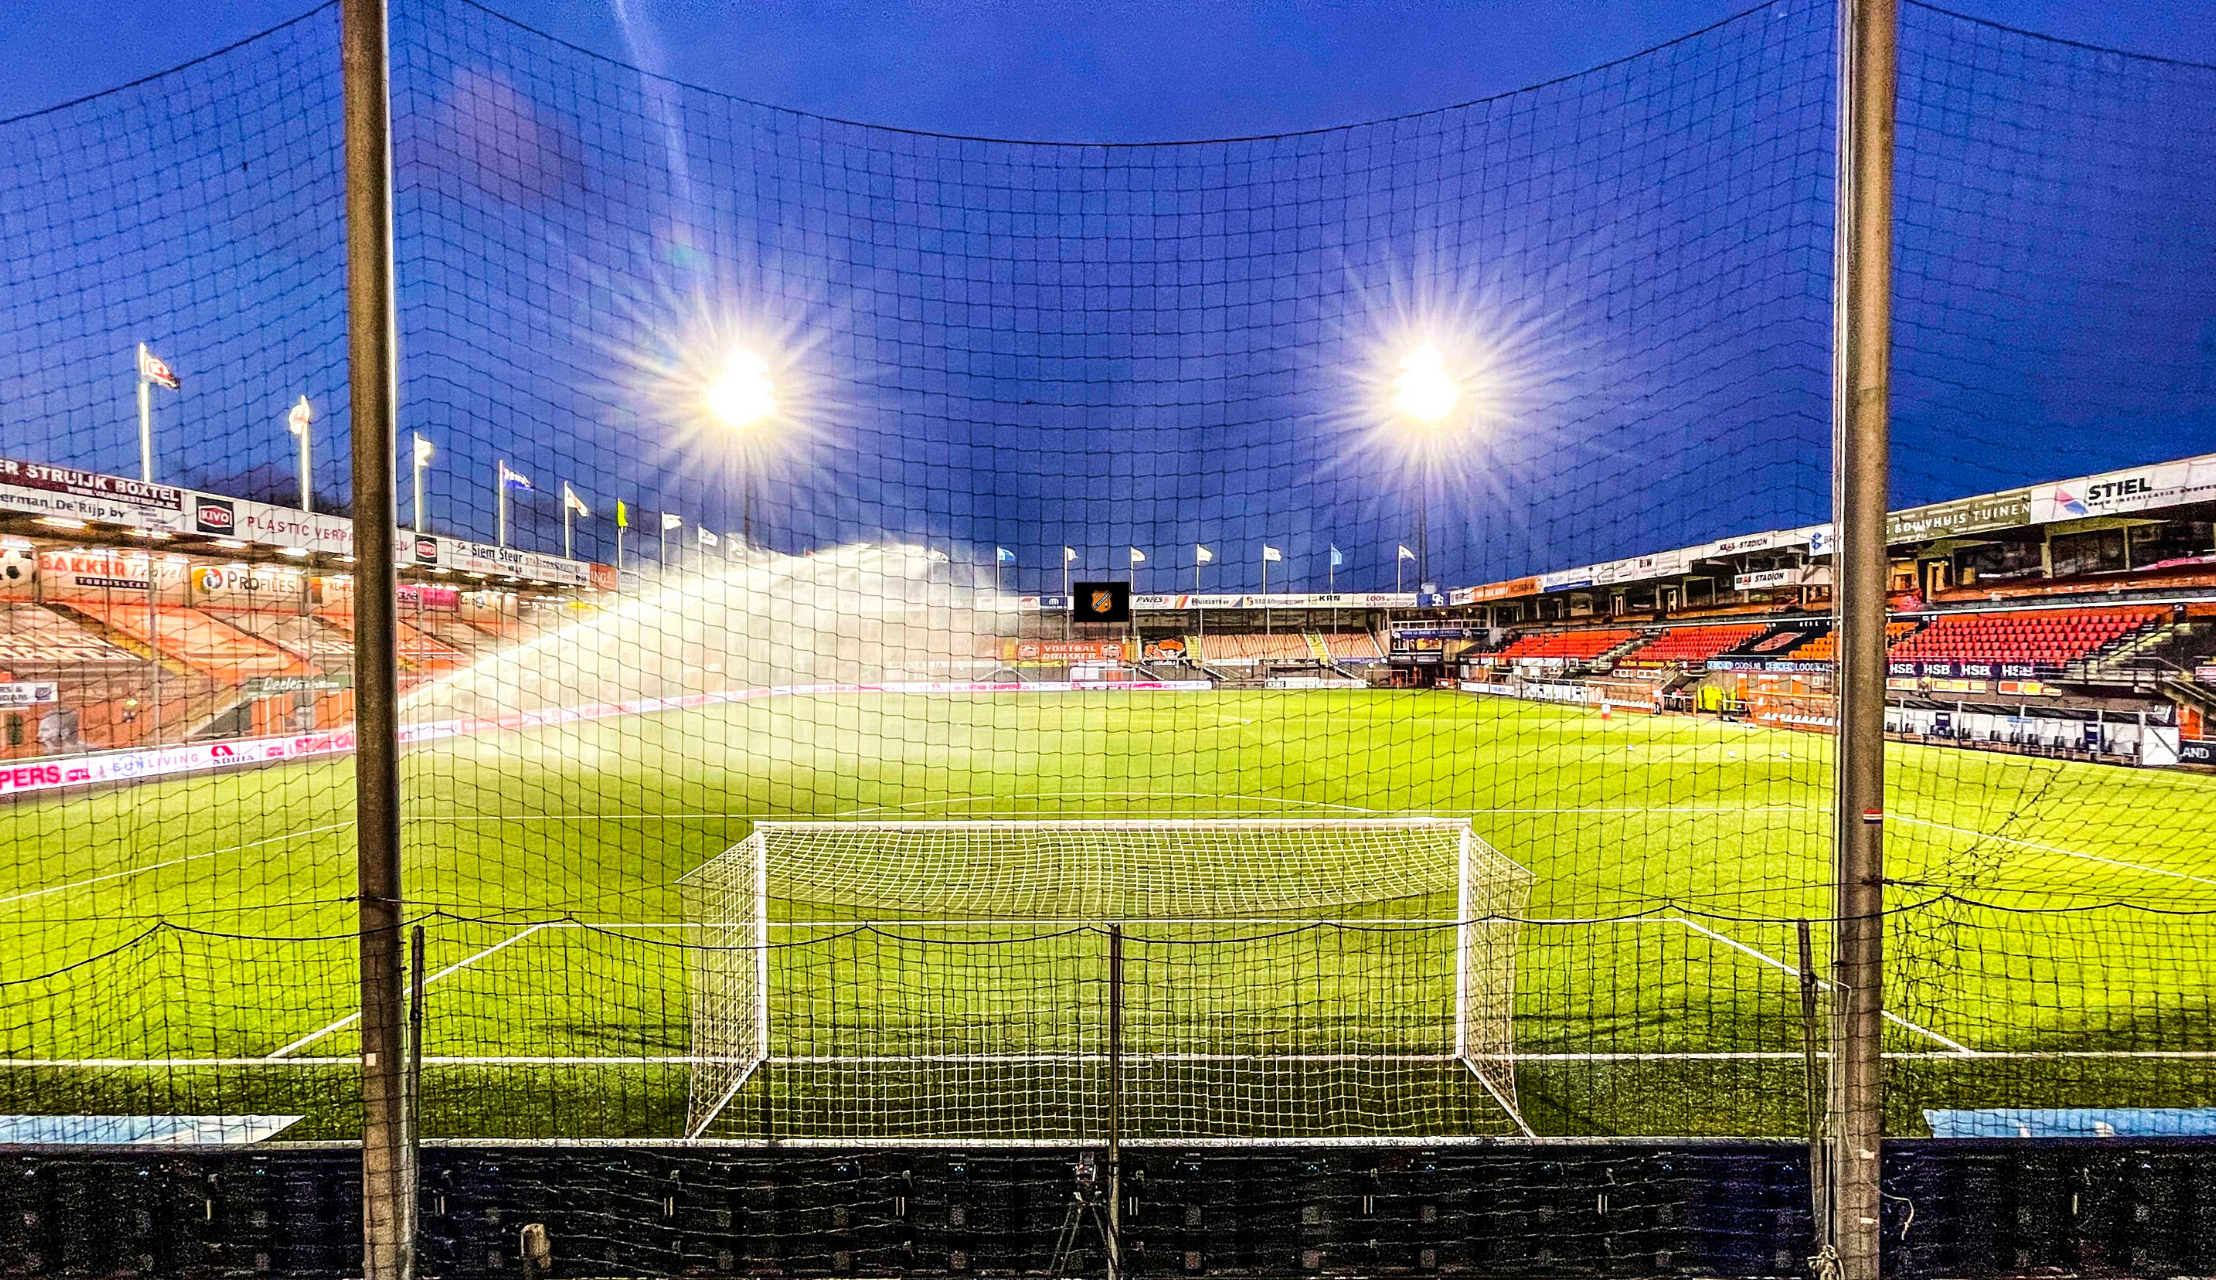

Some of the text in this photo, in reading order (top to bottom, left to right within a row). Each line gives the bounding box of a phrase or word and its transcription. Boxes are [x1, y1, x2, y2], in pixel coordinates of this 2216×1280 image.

[26, 465, 108, 490] STRUIJK
[115, 479, 180, 501] BOXTEL
[2089, 478, 2152, 500] STIEL
[56, 500, 74, 511] De
[80, 503, 105, 517] Rijp
[1973, 503, 2030, 521] TUINEN
[201, 509, 229, 523] KIVO
[248, 516, 310, 536] PLASTIC
[1740, 539, 1768, 549] STADION
[472, 544, 523, 563] Siem Steur
[41, 555, 183, 578] BAKKER Travel
[591, 571, 606, 583] ING
[1755, 573, 1784, 582] STADION
[1890, 664, 1914, 674] HSB
[1924, 664, 1950, 675] HSB
[1961, 664, 1990, 675] HSB
[2182, 747, 2209, 758] AND
[148, 753, 199, 768] LIVING
[213, 755, 255, 765] ADRIA
[0, 764, 61, 789] PERS
